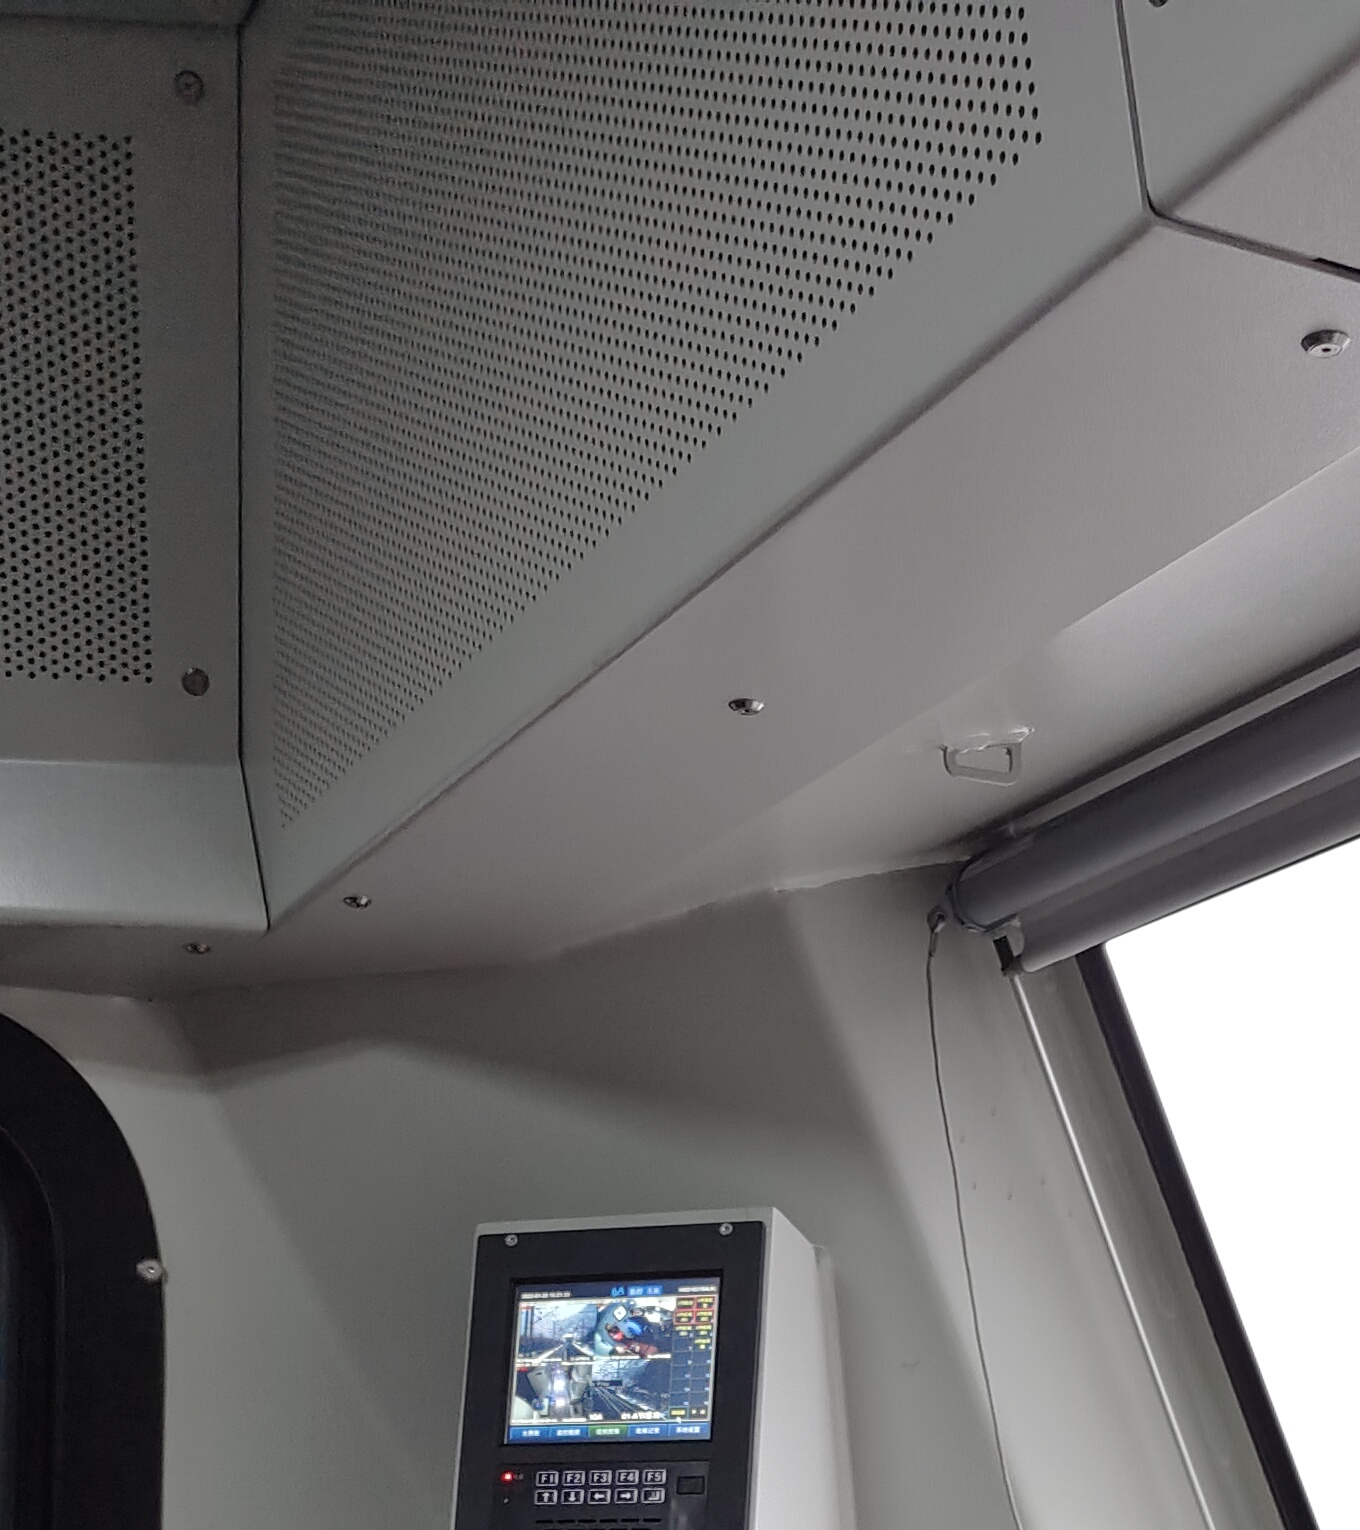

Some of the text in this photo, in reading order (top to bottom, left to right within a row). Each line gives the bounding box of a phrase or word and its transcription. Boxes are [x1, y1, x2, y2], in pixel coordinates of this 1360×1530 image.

[541, 1474, 554, 1484] F1
[568, 1473, 581, 1484] F2
[594, 1472, 607, 1483] F3
[620, 1471, 635, 1483] F4
[647, 1470, 662, 1482] F5
